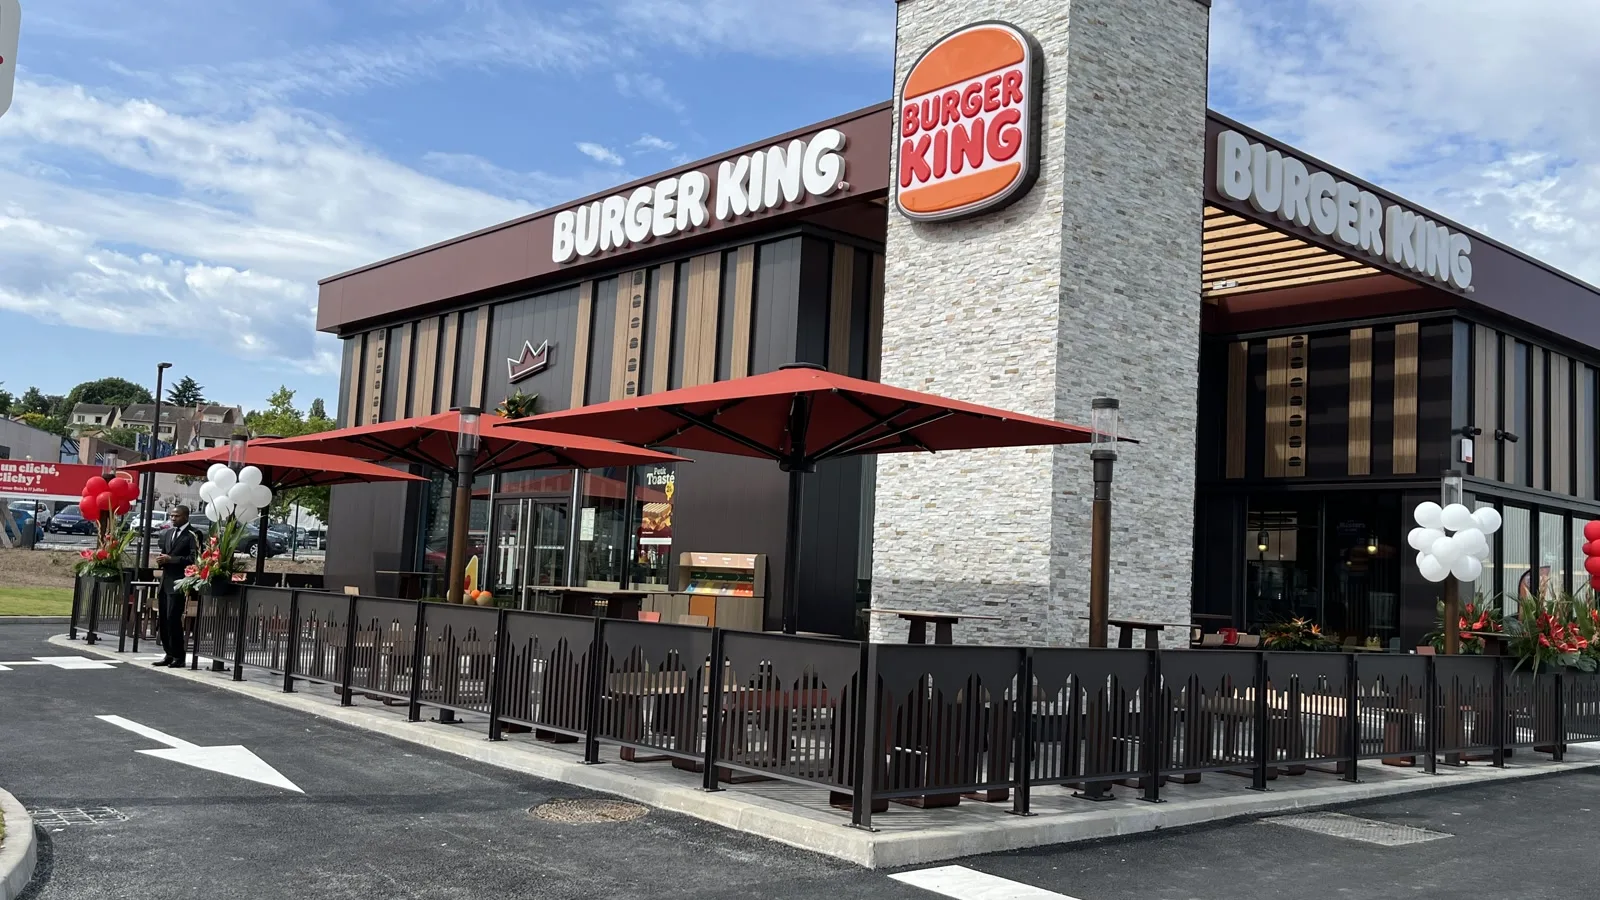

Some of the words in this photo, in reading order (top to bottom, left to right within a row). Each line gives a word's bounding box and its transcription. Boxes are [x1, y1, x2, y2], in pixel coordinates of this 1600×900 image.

[902, 69, 1023, 138] BURGER
[901, 107, 1022, 187] KING
[552, 170, 709, 263] BURGER
[716, 128, 846, 220] KING
[1217, 129, 1383, 256] BURGER
[1386, 204, 1472, 289] KING
[0, 463, 17, 472] un
[19, 463, 60, 476] cliché,
[0, 472, 35, 486] lichy
[646, 471, 675, 485] Toasté
